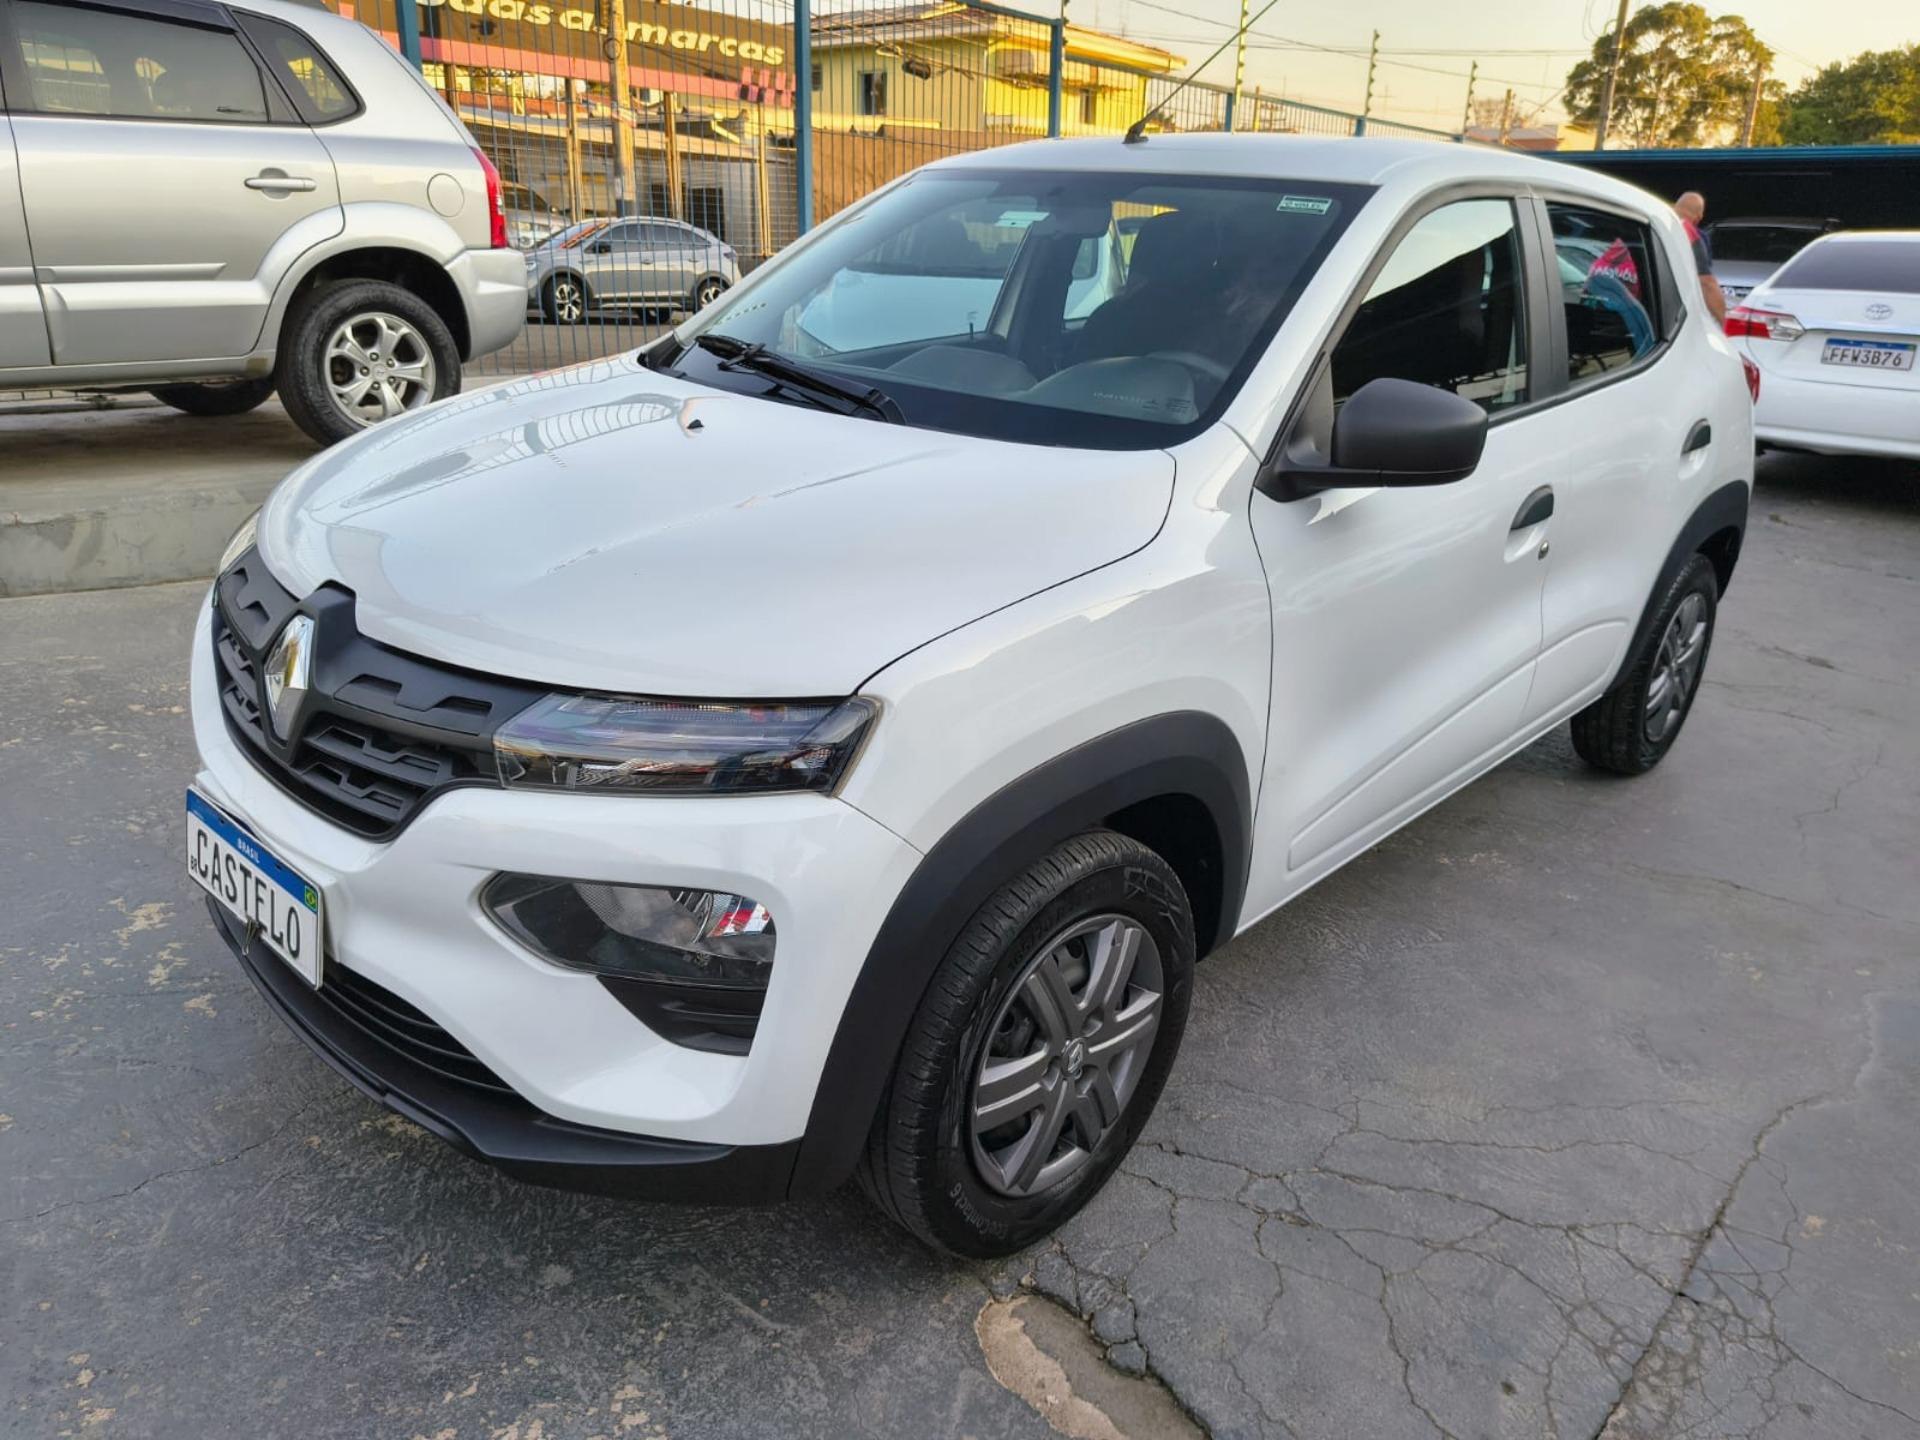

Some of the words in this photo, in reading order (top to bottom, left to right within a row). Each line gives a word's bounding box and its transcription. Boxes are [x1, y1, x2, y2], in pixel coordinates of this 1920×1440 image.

[559, 10, 607, 35] a
[626, 21, 785, 66] marcas
[1829, 347, 1902, 367] FFW3B76
[237, 837, 260, 864] BRASIL
[197, 828, 300, 959] CASTELO
